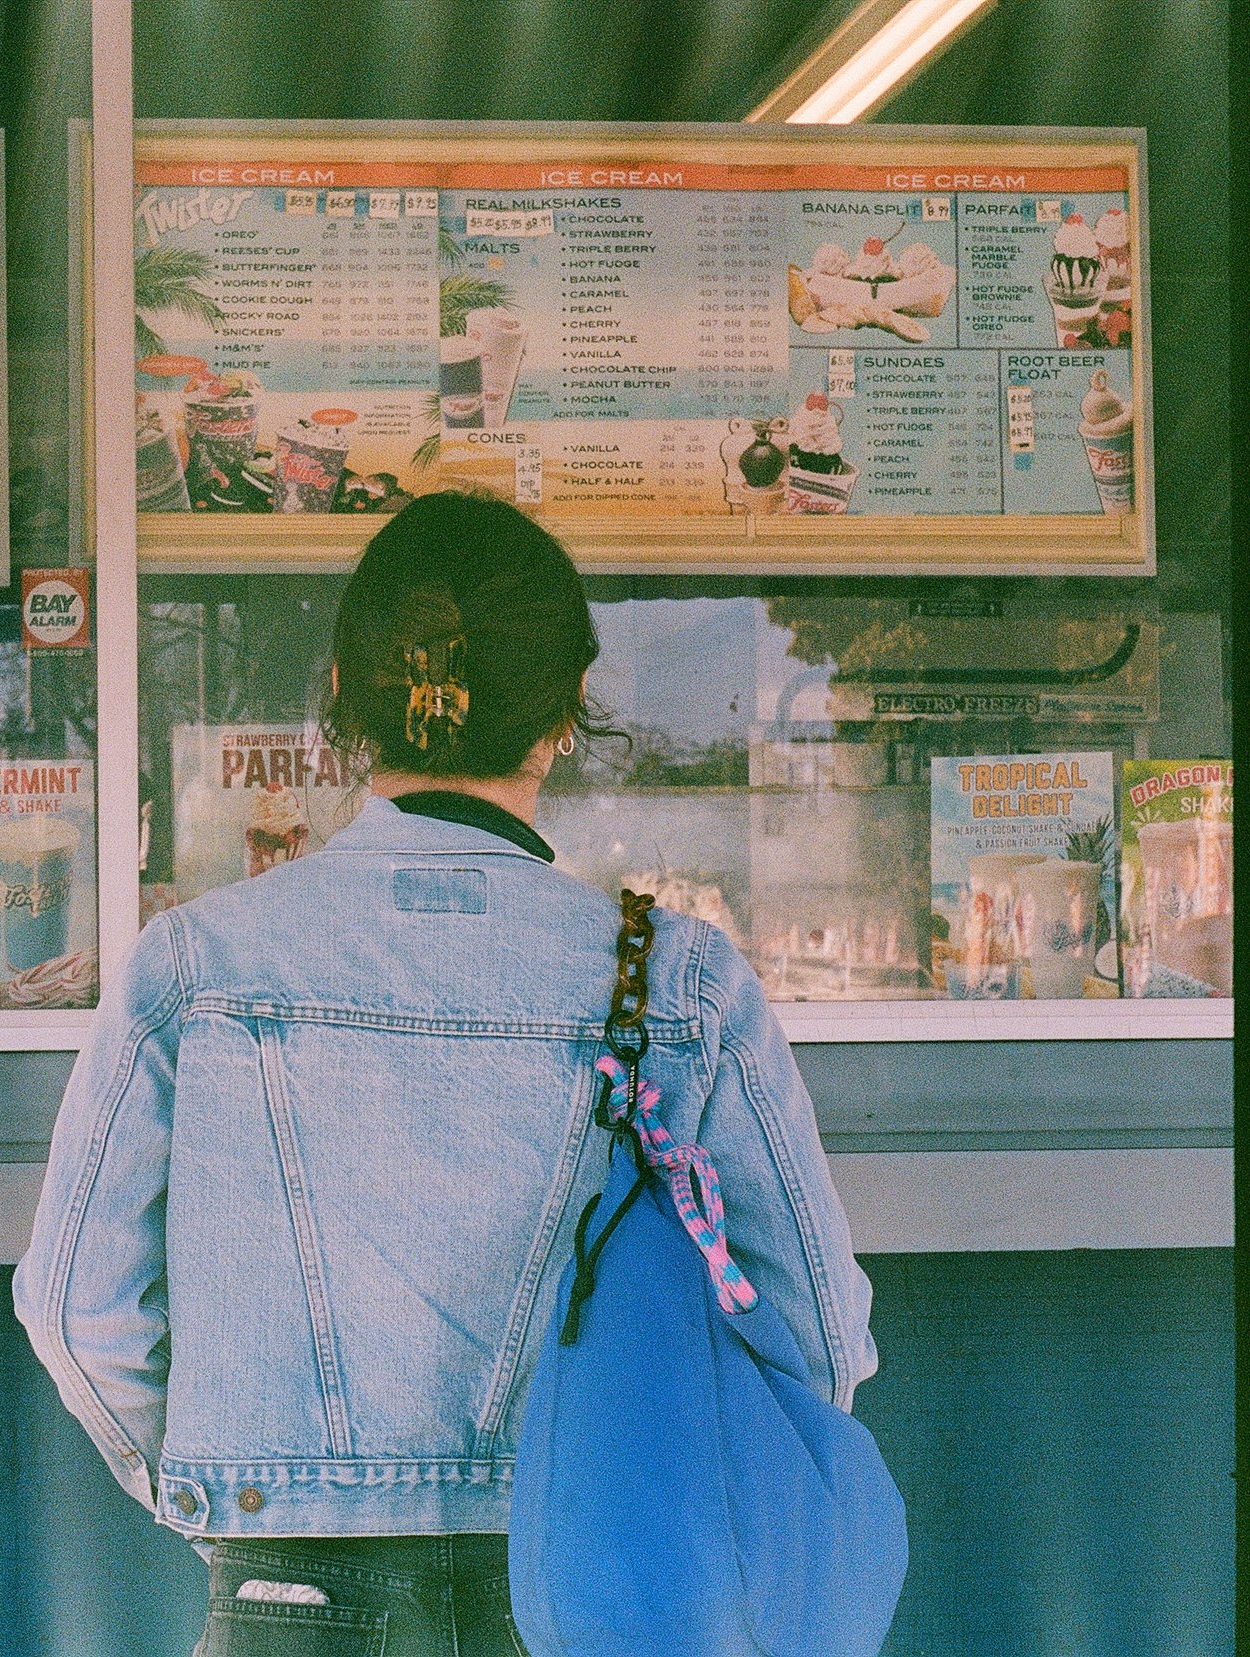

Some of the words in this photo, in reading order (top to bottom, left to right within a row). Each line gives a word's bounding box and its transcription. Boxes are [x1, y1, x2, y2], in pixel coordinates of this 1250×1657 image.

[191, 168, 234, 183] ICE
[240, 168, 335, 184] CREAM
[541, 171, 582, 186] ICE
[591, 171, 683, 186] CREAM
[886, 175, 925, 187] ICE
[935, 175, 1026, 187] CREAM
[466, 199, 508, 210] REAL
[512, 198, 621, 209] MILKSHAKES
[802, 203, 870, 214] BANANA
[874, 203, 920, 214] SPLIT
[965, 204, 1034, 215] PARFAIT
[570, 215, 645, 224] CHOCOLATE
[570, 230, 653, 239] STRAWBERRY
[465, 244, 520, 254] MALTS
[570, 260, 595, 268] HOT
[599, 260, 640, 268] FUDGE
[222, 280, 268, 288] WORMS
[285, 280, 313, 288] DIRT
[570, 290, 629, 298] CARAMEL
[222, 296, 268, 305] COOKIE
[270, 296, 313, 305] DOUGH
[570, 305, 612, 313] PEACH
[222, 312, 266, 321] ROCKY
[268, 312, 300, 320] ROAD
[570, 320, 621, 328] CHERRY
[570, 335, 638, 343] PINEAPPLE
[571, 350, 621, 358] VANILLA
[222, 360, 249, 370] MUD
[252, 360, 271, 369] PIE
[864, 357, 945, 368] SUNDAES
[1008, 356, 1053, 367] ROOT
[1058, 356, 1105, 366] BEER
[571, 365, 645, 373] CHOCOLATE
[873, 375, 936, 383] CHOCOLATE
[1008, 369, 1060, 380] FLOAT
[571, 380, 619, 389] PEANUT
[624, 380, 671, 389] BUTTER
[571, 395, 616, 404] MOCHA
[873, 391, 944, 399] STRAWBERRY
[873, 407, 909, 415] TRIPLE
[911, 407, 947, 415] BERRY
[873, 423, 894, 431] HOT
[898, 423, 933, 431] FUDGE
[467, 433, 526, 444] CONES
[874, 439, 924, 447] CARAMEL
[571, 444, 619, 452] VANILLA
[875, 455, 910, 463] PEACH
[571, 461, 643, 469] CHOCOLATE
[875, 471, 917, 479] CHERRY
[613, 477, 645, 485] HALF
[875, 487, 932, 495] PINEAPPLE
[30, 594, 78, 614] BAY
[29, 616, 78, 626] ALARM
[878, 696, 955, 713] ELECTRO
[223, 733, 296, 747] STRAWBERRY
[959, 761, 1088, 792] TROPICAL
[1130, 764, 1222, 808] DRAGON
[17, 799, 62, 813] SHAKE
[972, 793, 1074, 819] DELIGHT
[1181, 796, 1234, 813] SHAK
[985, 839, 1017, 848] PASSION
[1019, 838, 1041, 848] FRUIT
